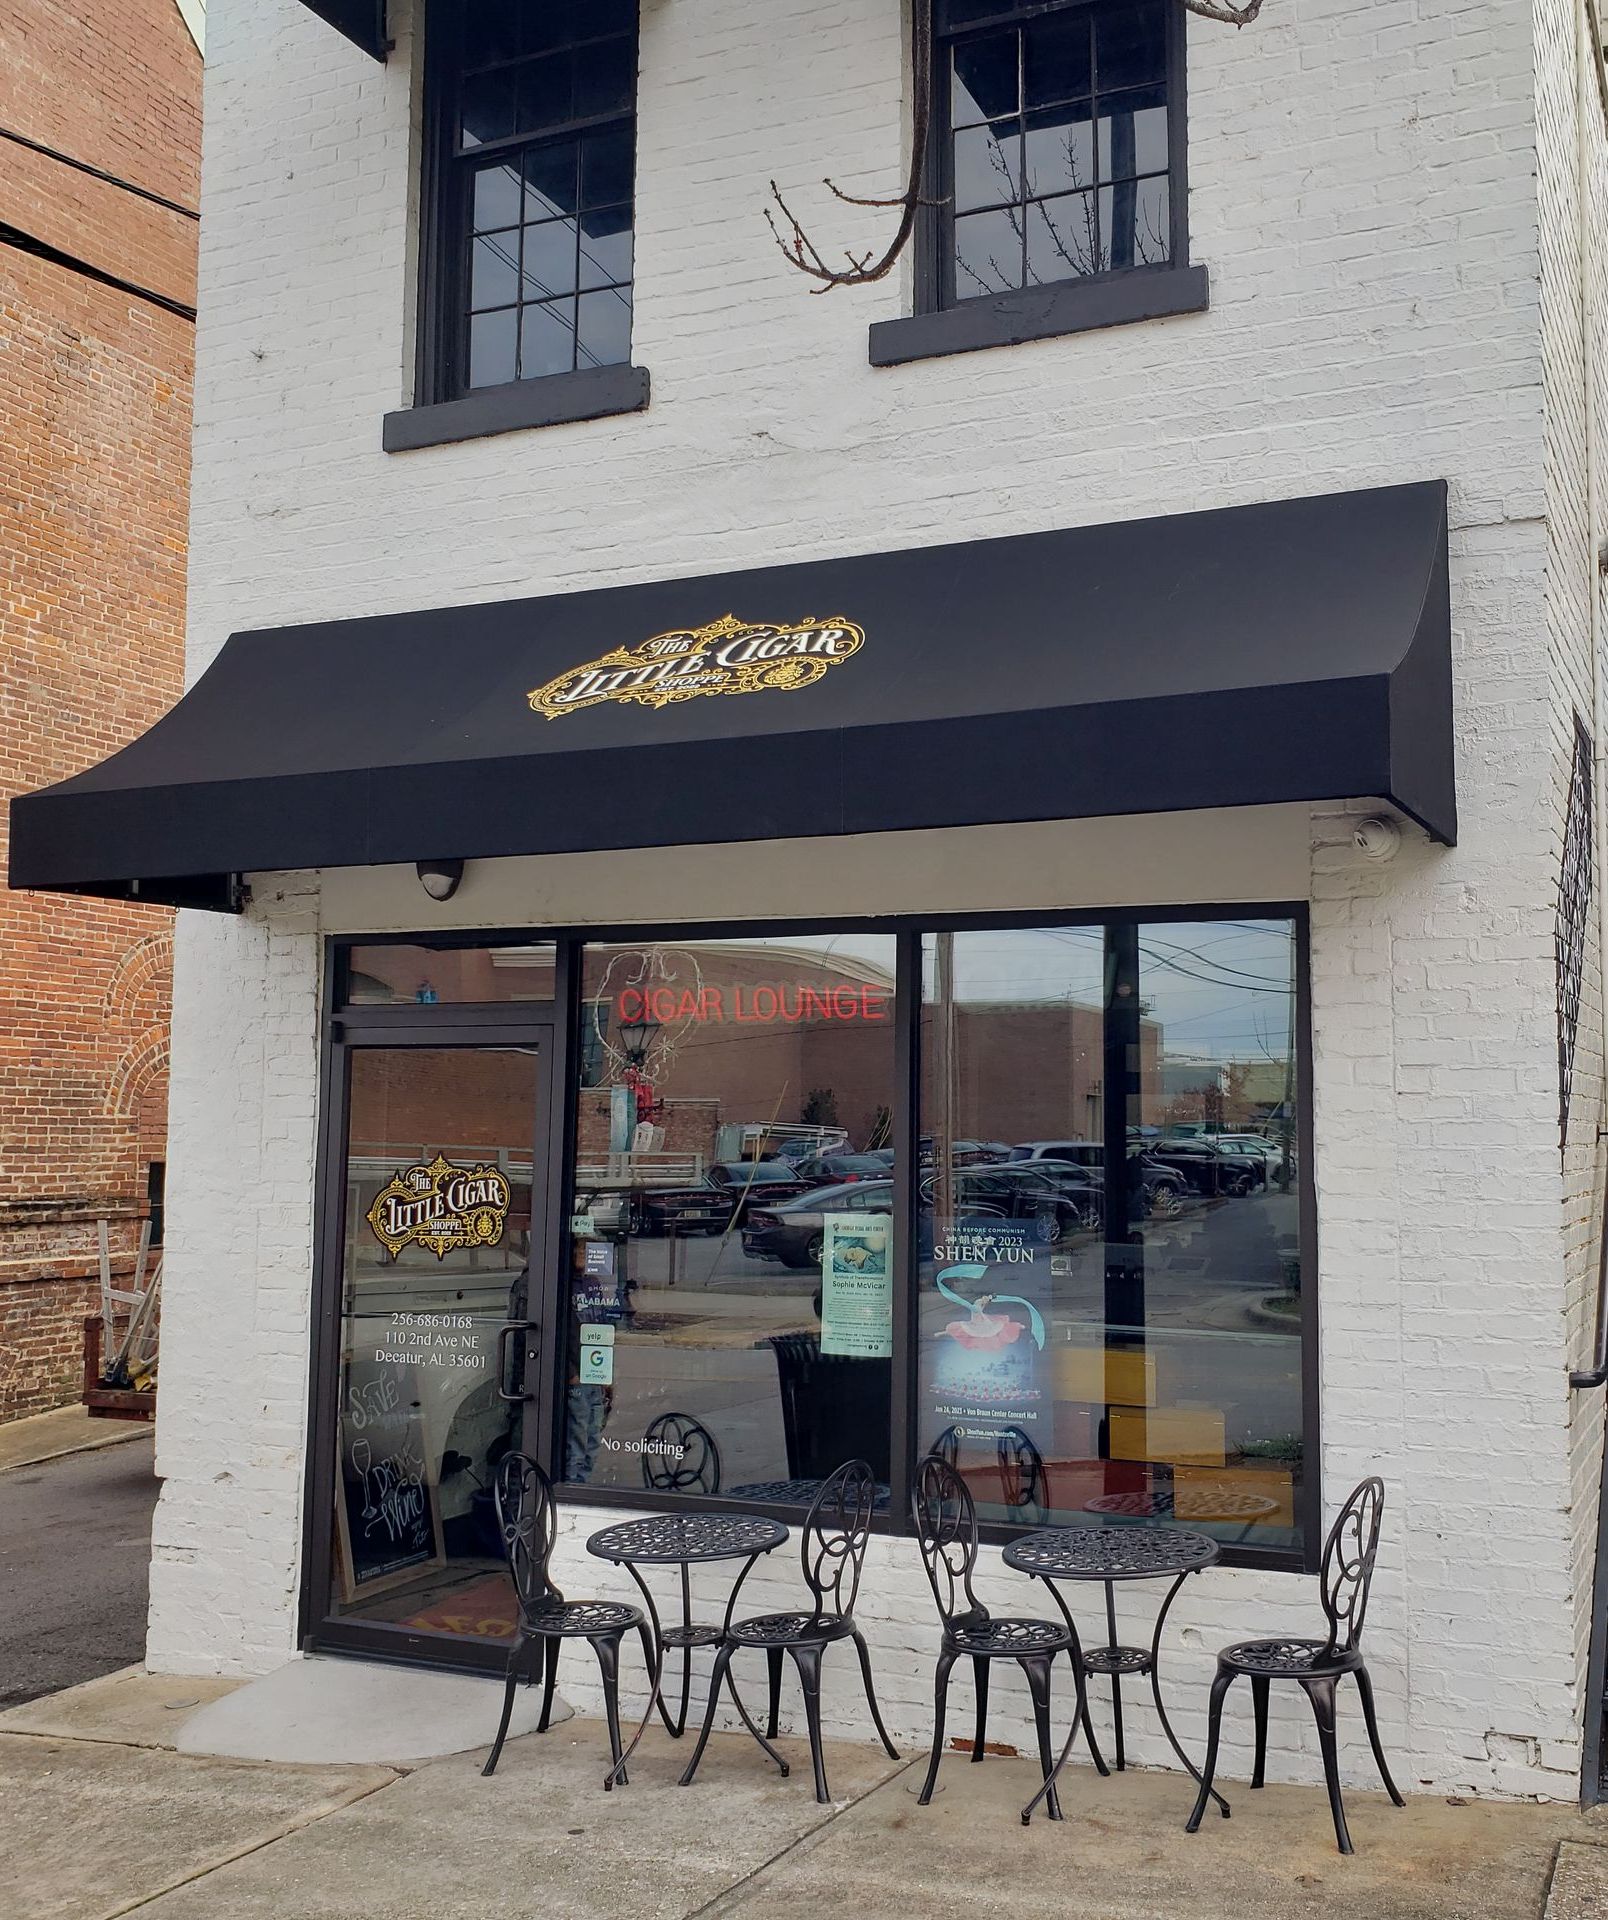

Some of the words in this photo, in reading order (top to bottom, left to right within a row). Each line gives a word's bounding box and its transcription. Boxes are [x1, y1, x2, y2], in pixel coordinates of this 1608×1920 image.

[555, 650, 710, 702] LITTLE
[716, 627, 846, 667] CIGAR
[655, 674, 728, 688] SHOPPE
[619, 987, 724, 1023] CIGAR
[735, 985, 887, 1021] LOUNGE
[386, 1193, 445, 1234] LITTLE
[447, 1177, 504, 1213] CIGAR
[430, 1220, 461, 1230] SHOPPE
[999, 1236, 1023, 1247] 2023
[934, 1245, 986, 1262] SHEN
[992, 1247, 1034, 1264] YUN
[832, 1280, 855, 1289] Sophie
[857, 1281, 886, 1290] McVicar
[576, 1297, 620, 1306] ALABAMA
[392, 1313, 473, 1329] 256-686-0168
[385, 1332, 406, 1345] 110
[410, 1332, 432, 1346] 2nd
[435, 1334, 458, 1347] Ave
[461, 1335, 479, 1349] NE
[587, 1332, 601, 1340] yelp
[375, 1350, 426, 1367] Decatur,
[430, 1353, 446, 1366] AL
[449, 1354, 486, 1368] 35601
[350, 1368, 400, 1429] SAVE
[601, 1437, 620, 1450] No
[624, 1438, 685, 1460] soliciting
